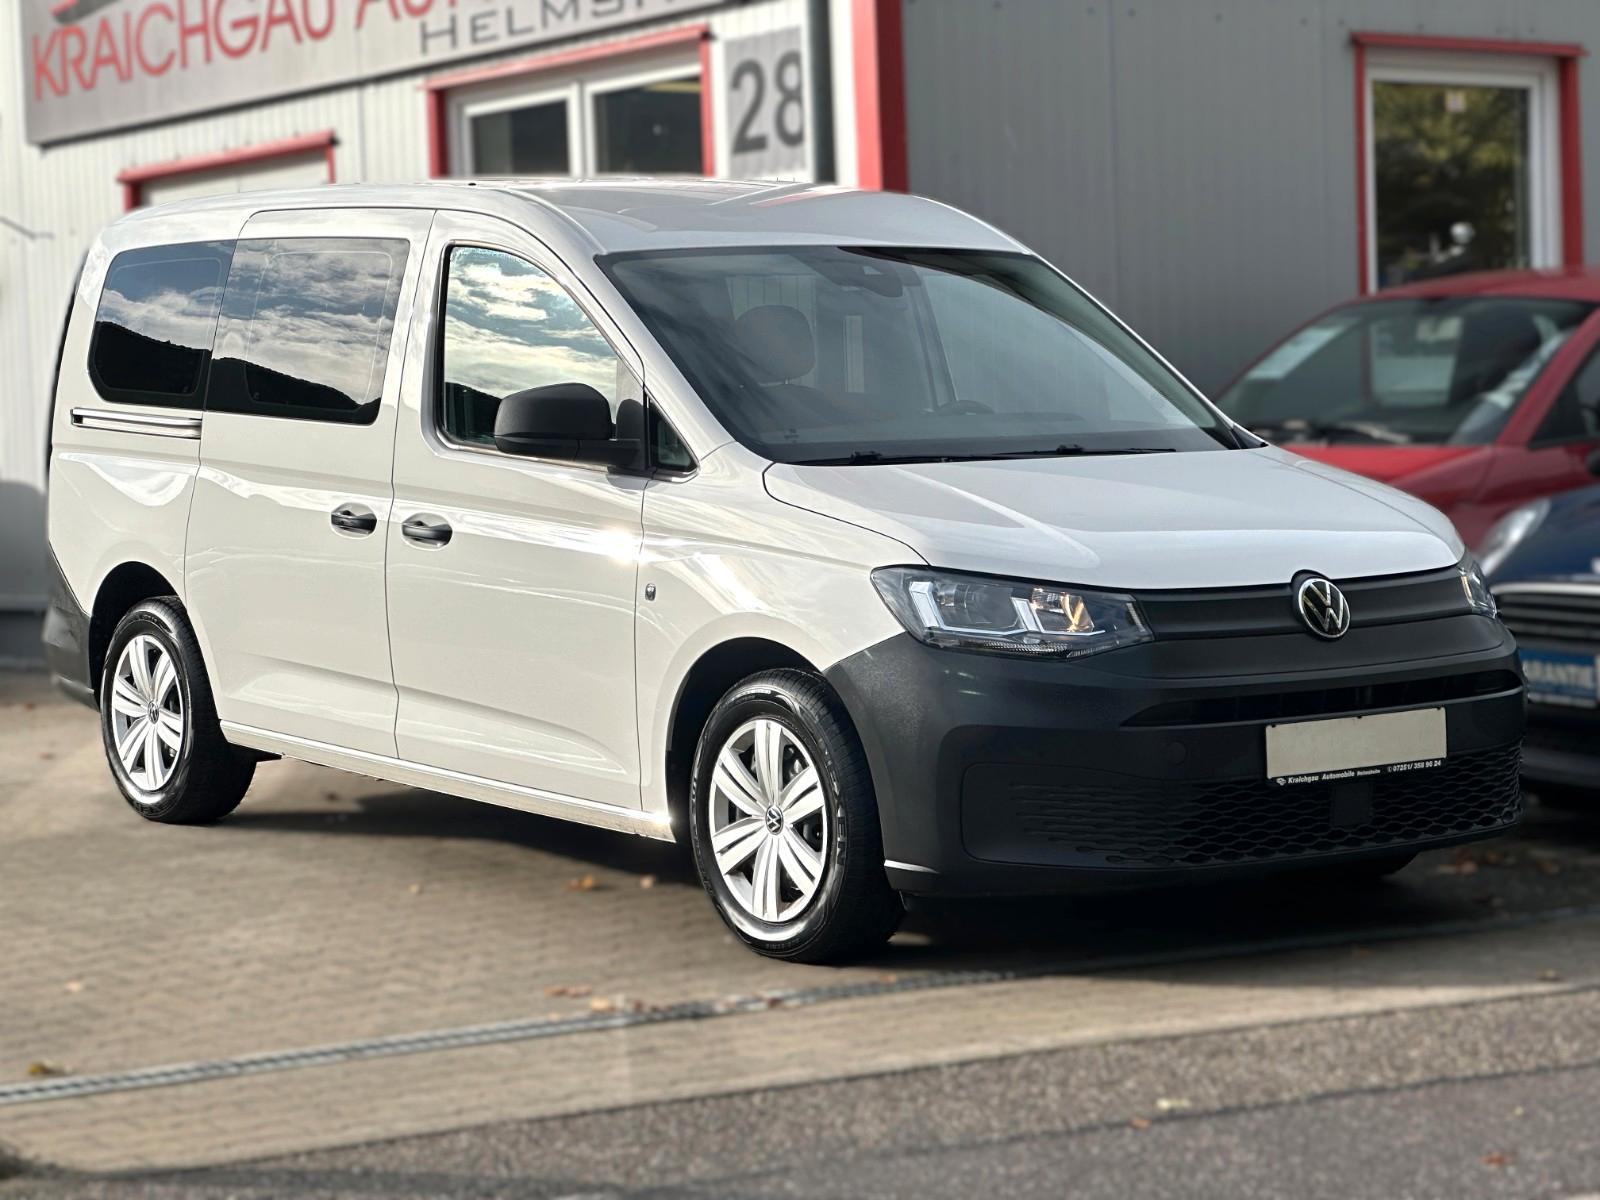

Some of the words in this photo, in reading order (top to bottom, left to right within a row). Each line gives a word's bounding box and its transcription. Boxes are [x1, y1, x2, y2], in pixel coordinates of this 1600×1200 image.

[31, 0, 336, 101] KRAICHGAU
[420, 0, 673, 56] HELMS
[730, 50, 804, 156] 28
[1322, 771, 1355, 780] Automobile
